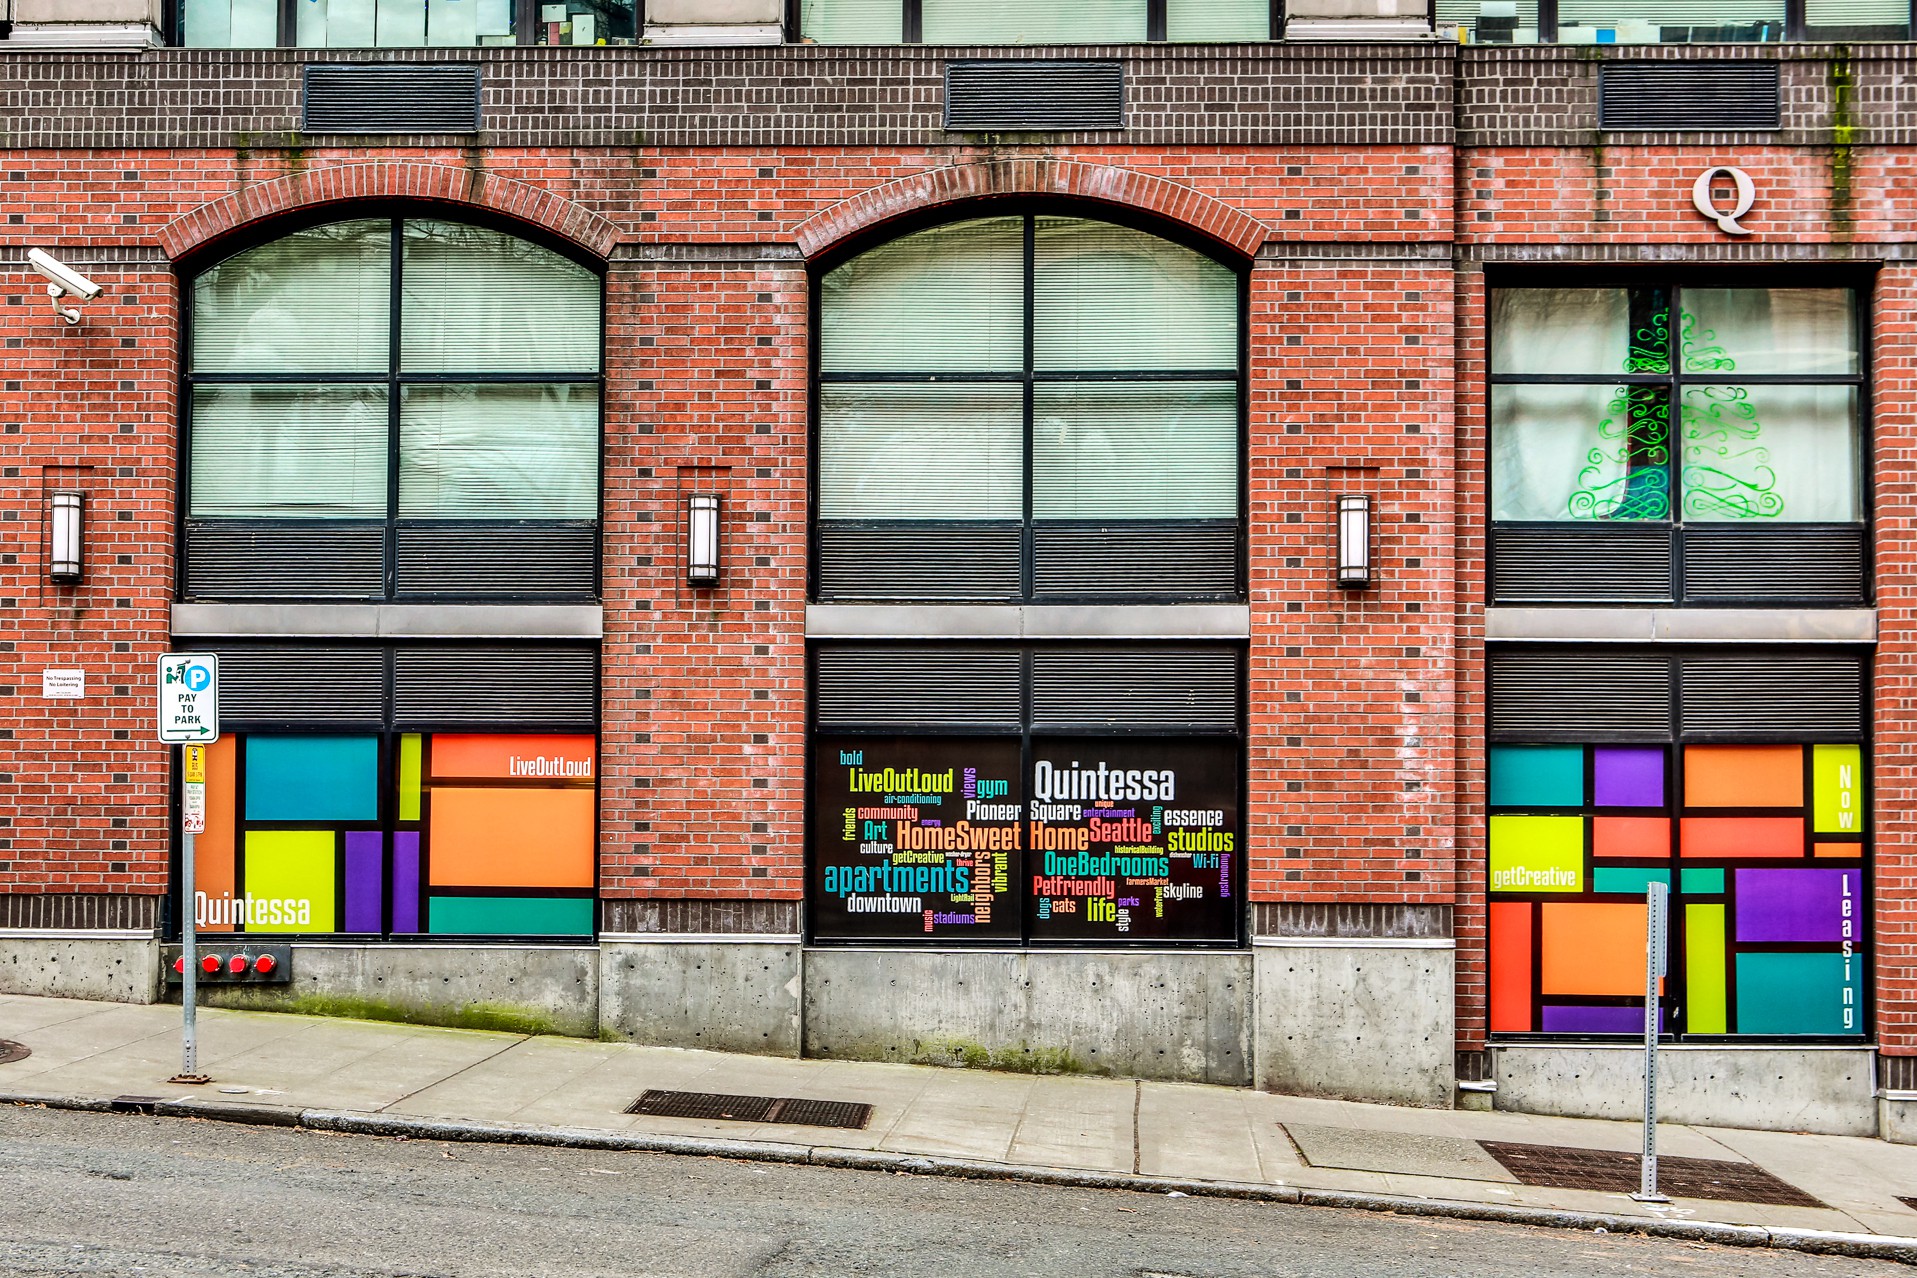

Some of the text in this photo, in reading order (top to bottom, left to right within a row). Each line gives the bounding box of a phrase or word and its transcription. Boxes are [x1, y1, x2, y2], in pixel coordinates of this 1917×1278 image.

[1692, 166, 1756, 234] Q
[190, 669, 206, 689] P
[178, 694, 197, 702] PAY
[181, 705, 194, 713] TO
[174, 716, 201, 724] PARK
[509, 756, 591, 776] LiveOutLoud
[840, 750, 863, 765] bold
[849, 767, 954, 793] LiveOutLoud
[960, 767, 977, 799] views
[976, 779, 1008, 799] gym
[1034, 760, 1175, 803] Quintessa
[884, 793, 942, 806] air-conditioning
[966, 799, 1022, 821] Pioneer
[857, 804, 918, 822] community
[1029, 799, 1082, 824] Square
[1082, 807, 1135, 818] entertainment
[1163, 809, 1224, 827] essence
[842, 807, 856, 841] friends
[864, 820, 888, 841] Art
[1089, 817, 1153, 843] Seattle
[896, 820, 1022, 851] HomeSweet
[1029, 820, 1089, 851] Home
[1167, 826, 1235, 852] studios
[860, 840, 894, 855] culture
[892, 850, 945, 866] getCreative
[956, 858, 974, 868] thrive
[1044, 850, 1169, 877] OneBedrooms
[1192, 853, 1219, 869] Wi-Fi
[824, 858, 970, 899] apartments
[991, 852, 1008, 893] vibrant
[1493, 865, 1577, 889] getCreative
[970, 851, 995, 924] neighbors
[1033, 875, 1116, 900] PetFriendly
[1163, 882, 1204, 901] skyline
[194, 891, 311, 928] Quintessa
[847, 892, 922, 914] downtown
[1036, 897, 1052, 920] dogs
[1052, 897, 1077, 914] cats
[1086, 896, 1117, 923] life
[1117, 896, 1140, 908] parks
[922, 909, 934, 933] music
[933, 911, 976, 925] stadiums
[1115, 908, 1132, 932] style
[1841, 873, 1854, 1030] Leasing
